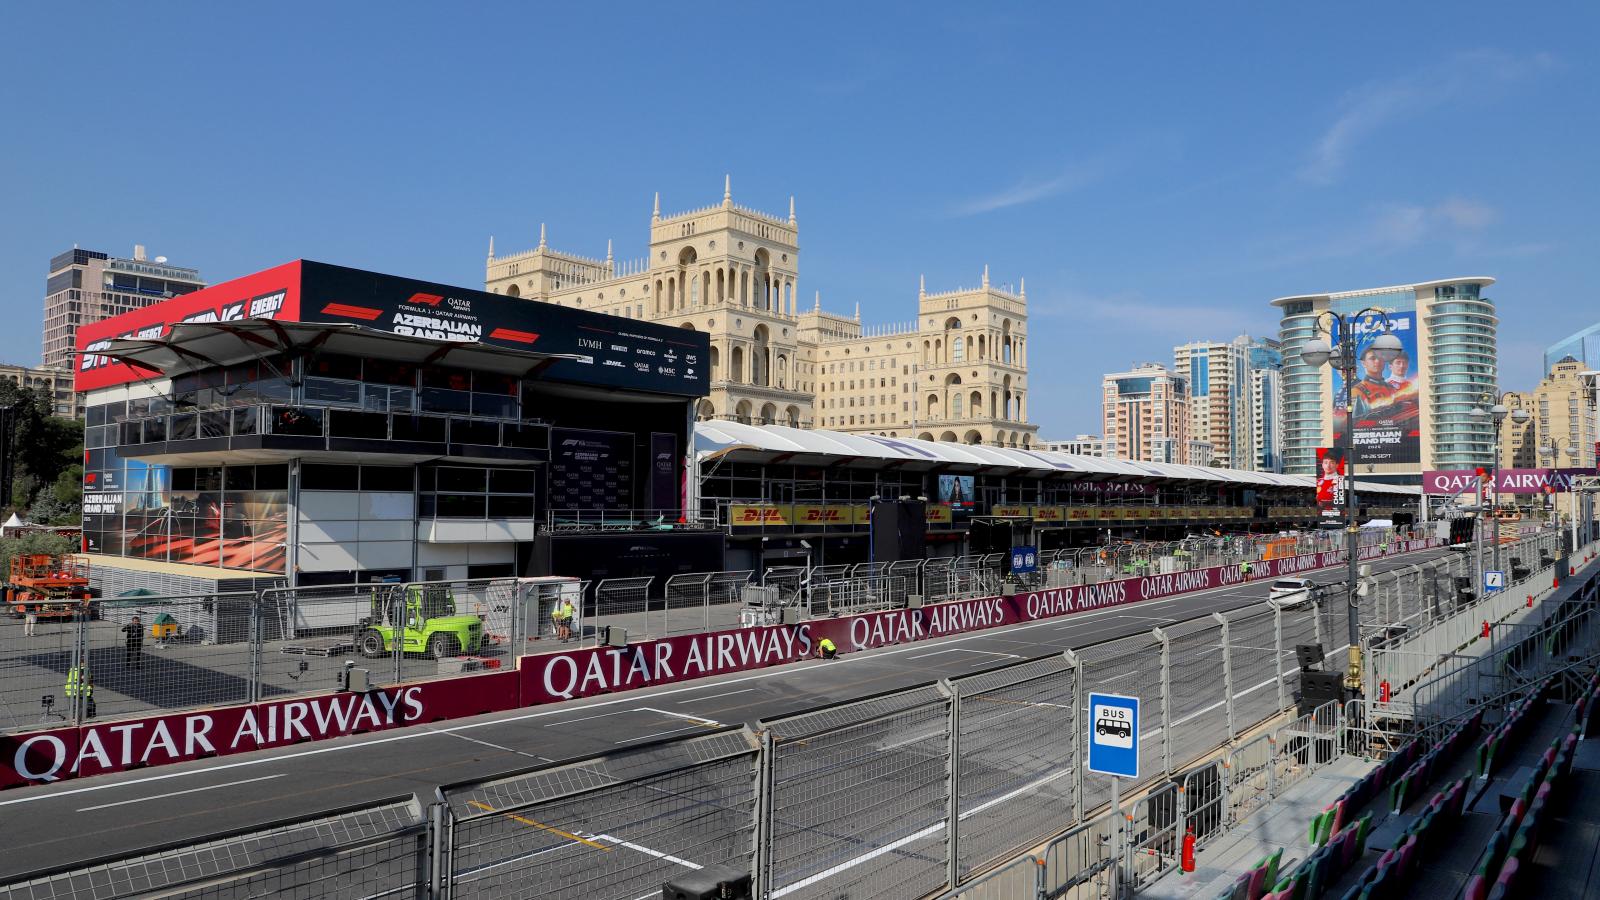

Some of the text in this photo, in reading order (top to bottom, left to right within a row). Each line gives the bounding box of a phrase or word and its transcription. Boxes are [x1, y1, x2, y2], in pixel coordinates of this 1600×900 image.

[249, 292, 286, 317] ENERGY
[398, 304, 426, 314] FORMULA
[435, 310, 454, 318] QATAR
[447, 298, 471, 308] QATAR
[392, 312, 482, 336] AZERBAIJAN
[578, 338, 602, 350] LVMH
[84, 494, 122, 504] AZERBAIJAN
[84, 504, 116, 513] GRAND PRIX
[743, 509, 780, 522] DHL
[807, 509, 840, 521] DHL
[1220, 564, 1243, 585] QATA
[1277, 557, 1296, 575] QATAR
[1140, 569, 1210, 600] QATAR AIRWAYS
[1027, 581, 1127, 618] QATAR AIRWAYS
[851, 599, 1003, 650] QATAR AIRWAYS
[543, 624, 811, 700] QATAR AIRWAYS
[1103, 709, 1125, 719] BUS
[14, 687, 424, 782] QATAR AIRWAYS
